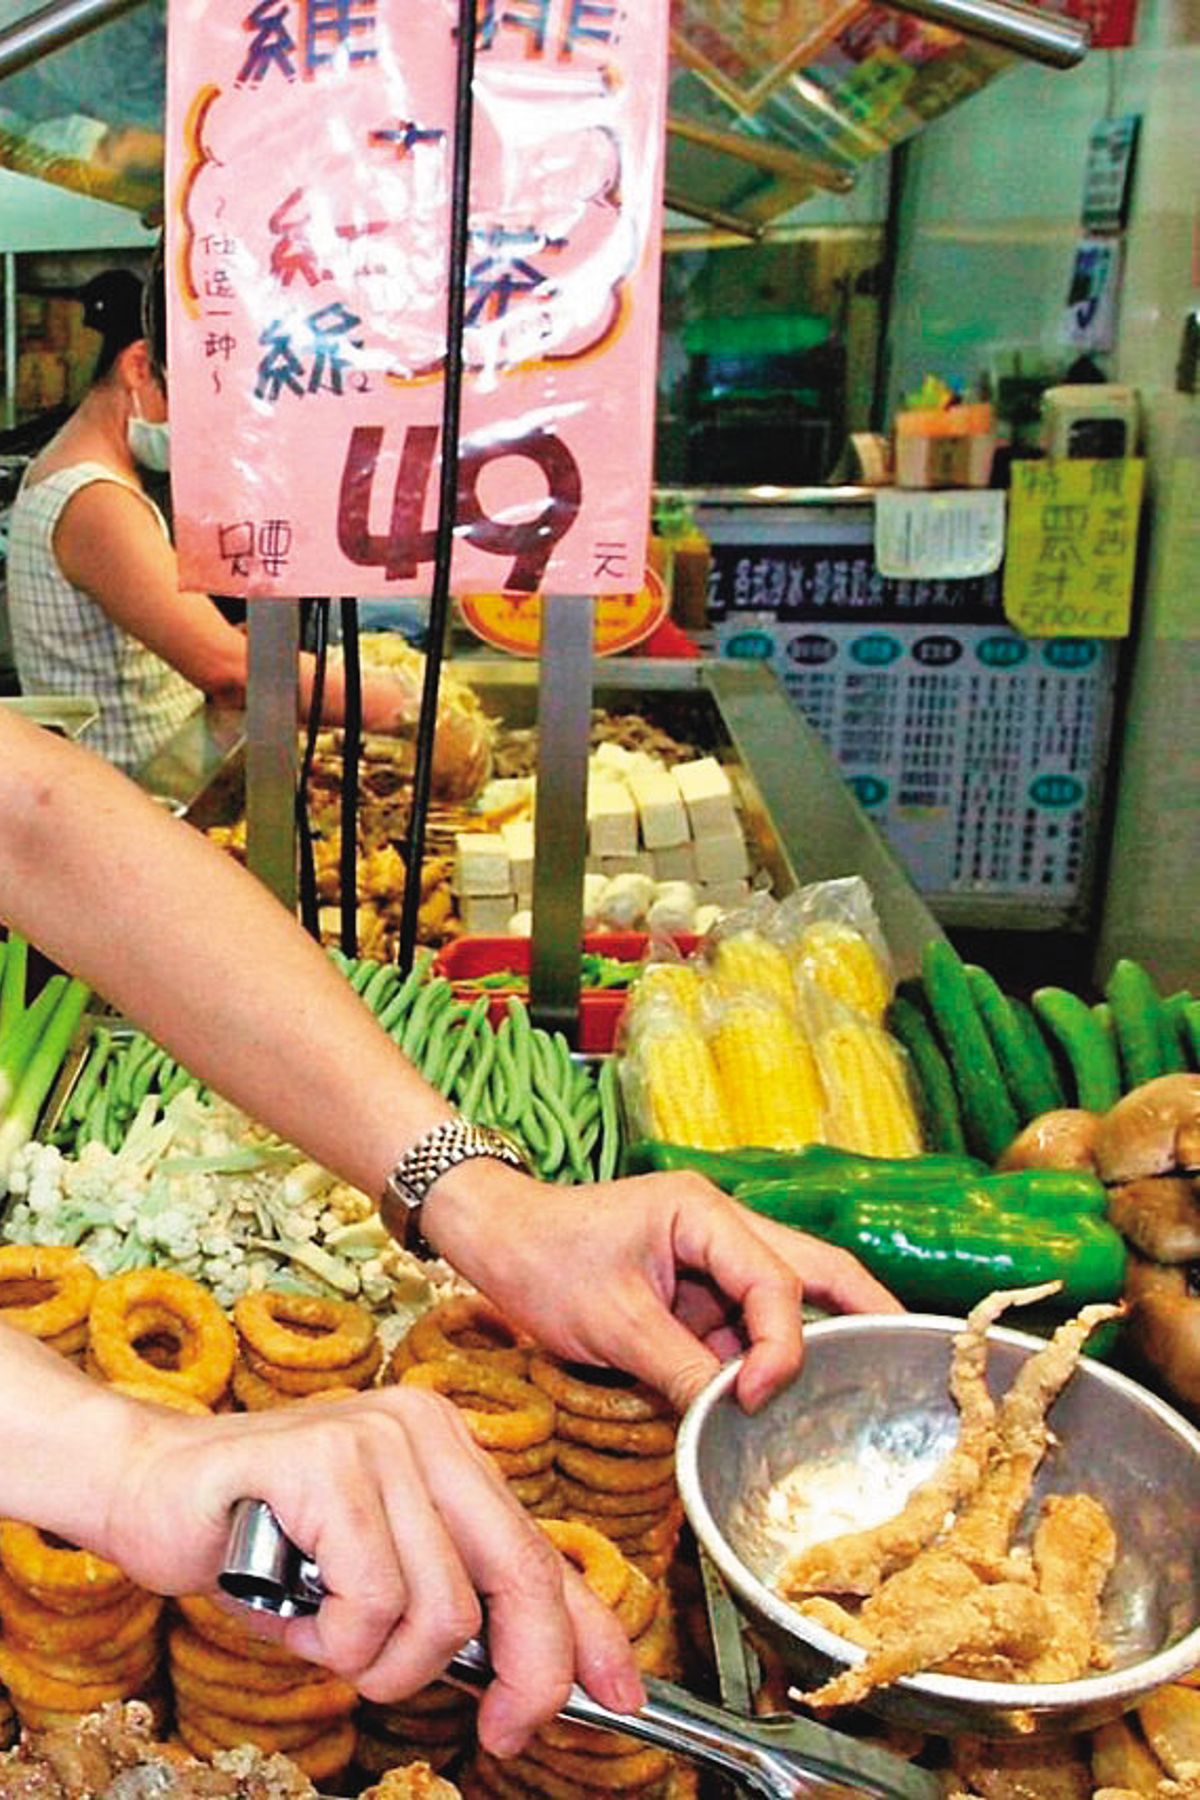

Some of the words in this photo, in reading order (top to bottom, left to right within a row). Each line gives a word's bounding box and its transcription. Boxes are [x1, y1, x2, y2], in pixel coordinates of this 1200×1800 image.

[218, 519, 293, 578] 只要
[337, 424, 583, 593] 49
[593, 542, 628, 579] 元
